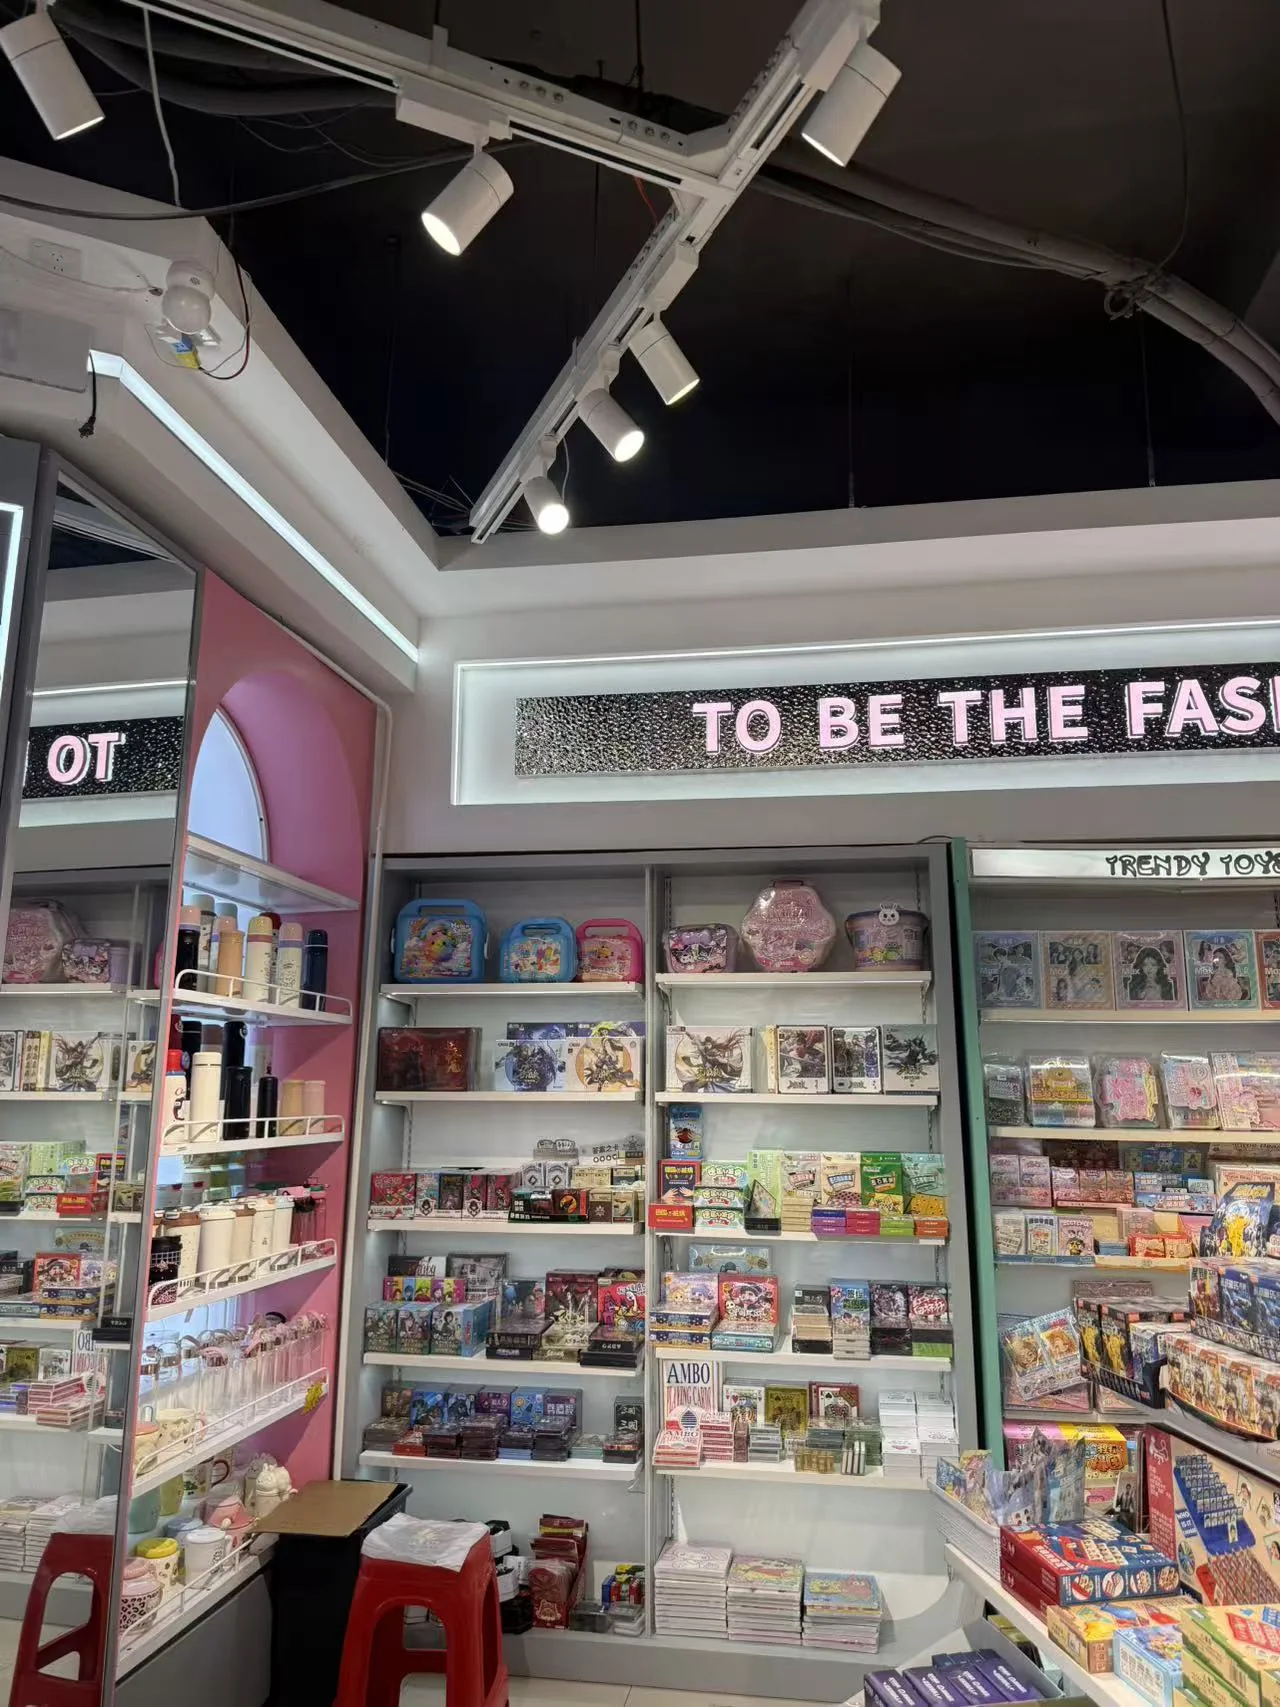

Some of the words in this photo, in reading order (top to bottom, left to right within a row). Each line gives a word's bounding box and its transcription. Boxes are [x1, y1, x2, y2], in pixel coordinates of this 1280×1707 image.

[693, 700, 781, 754] TO
[818, 694, 904, 750] BE
[938, 685, 1089, 746] THE
[1105, 852, 1211, 877] TRENDY
[667, 1363, 710, 1384] AMBO
